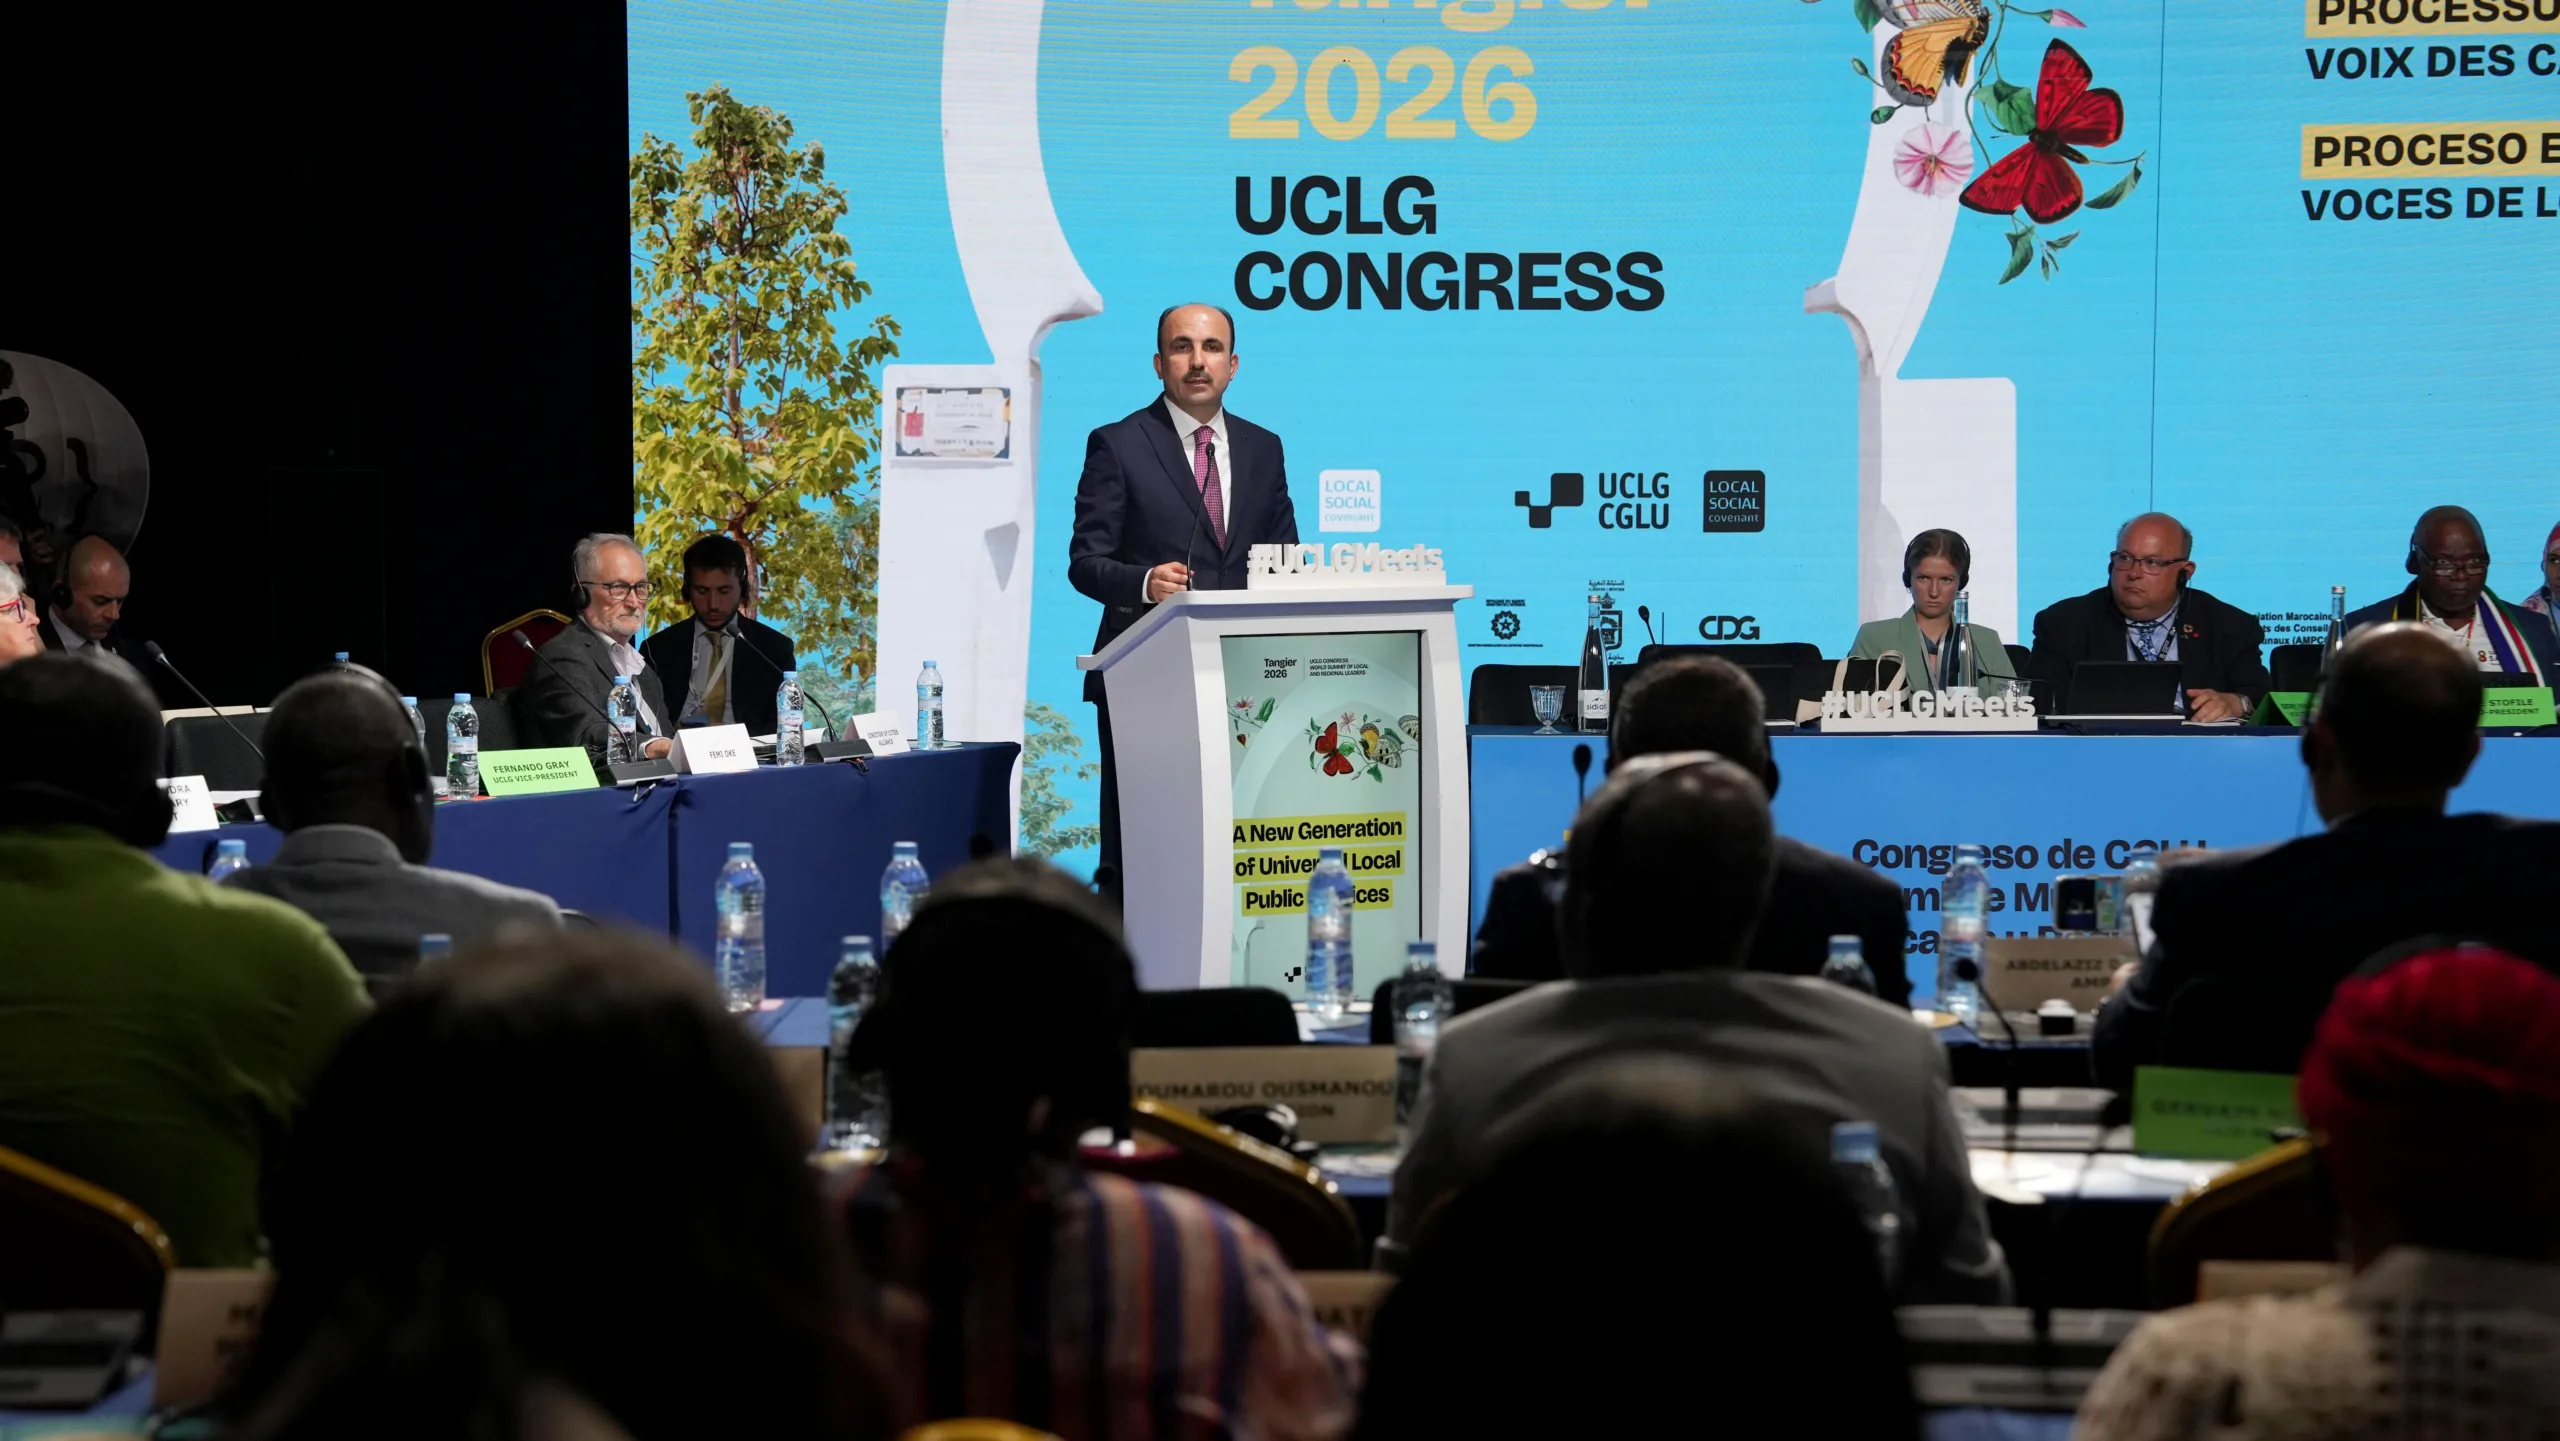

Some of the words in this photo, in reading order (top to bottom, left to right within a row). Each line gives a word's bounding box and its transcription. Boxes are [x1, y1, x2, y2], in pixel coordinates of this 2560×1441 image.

[2305, 46, 2414, 79] VOIX
[2427, 44, 2515, 77] DES
[2528, 43, 2560, 76] C
[1228, 46, 1537, 140] 2026
[2314, 132, 2527, 167] PROCESO
[1235, 175, 1436, 235] UCLG
[2301, 187, 2452, 221] VOCES
[2466, 186, 2524, 218] DE
[2536, 186, 2560, 217] L
[1234, 251, 1664, 312] CONGRESS
[1325, 480, 1375, 492] LOCAL
[1598, 472, 1670, 499] UCLG
[1709, 480, 1760, 493] LOCAL
[1325, 496, 1376, 509] SOCIAL
[1709, 497, 1760, 510] SOCIAL
[1324, 513, 1375, 522] covenant
[1598, 502, 1670, 529] CGLU
[1708, 513, 1760, 523] covenant
[1247, 542, 1444, 574] #UCLGMeets
[2257, 612, 2284, 620] iation
[1698, 615, 1760, 640] CDG
[2274, 624, 2291, 632] des
[2293, 623, 2329, 632] Conseil
[1264, 657, 1297, 669] Tangier
[1264, 669, 1288, 679] 2026
[1821, 689, 2036, 719] #UCLGMeets
[2489, 698, 2533, 706] STOFILE
[493, 762, 543, 774] FERNANDO
[545, 760, 570, 770] GRAY
[493, 775, 514, 784] UCLG
[515, 771, 578, 782] VICE-PRESIDENT
[1233, 825, 1246, 843] A
[1251, 824, 1294, 842] New
[1298, 818, 1402, 840] Generation
[1235, 857, 1256, 877] of
[1260, 852, 1348, 876] Univerl
[1352, 850, 1401, 871] Local
[1853, 839, 2039, 875] Congeso
[2047, 838, 2096, 869] de
[1246, 889, 1304, 909] Public
